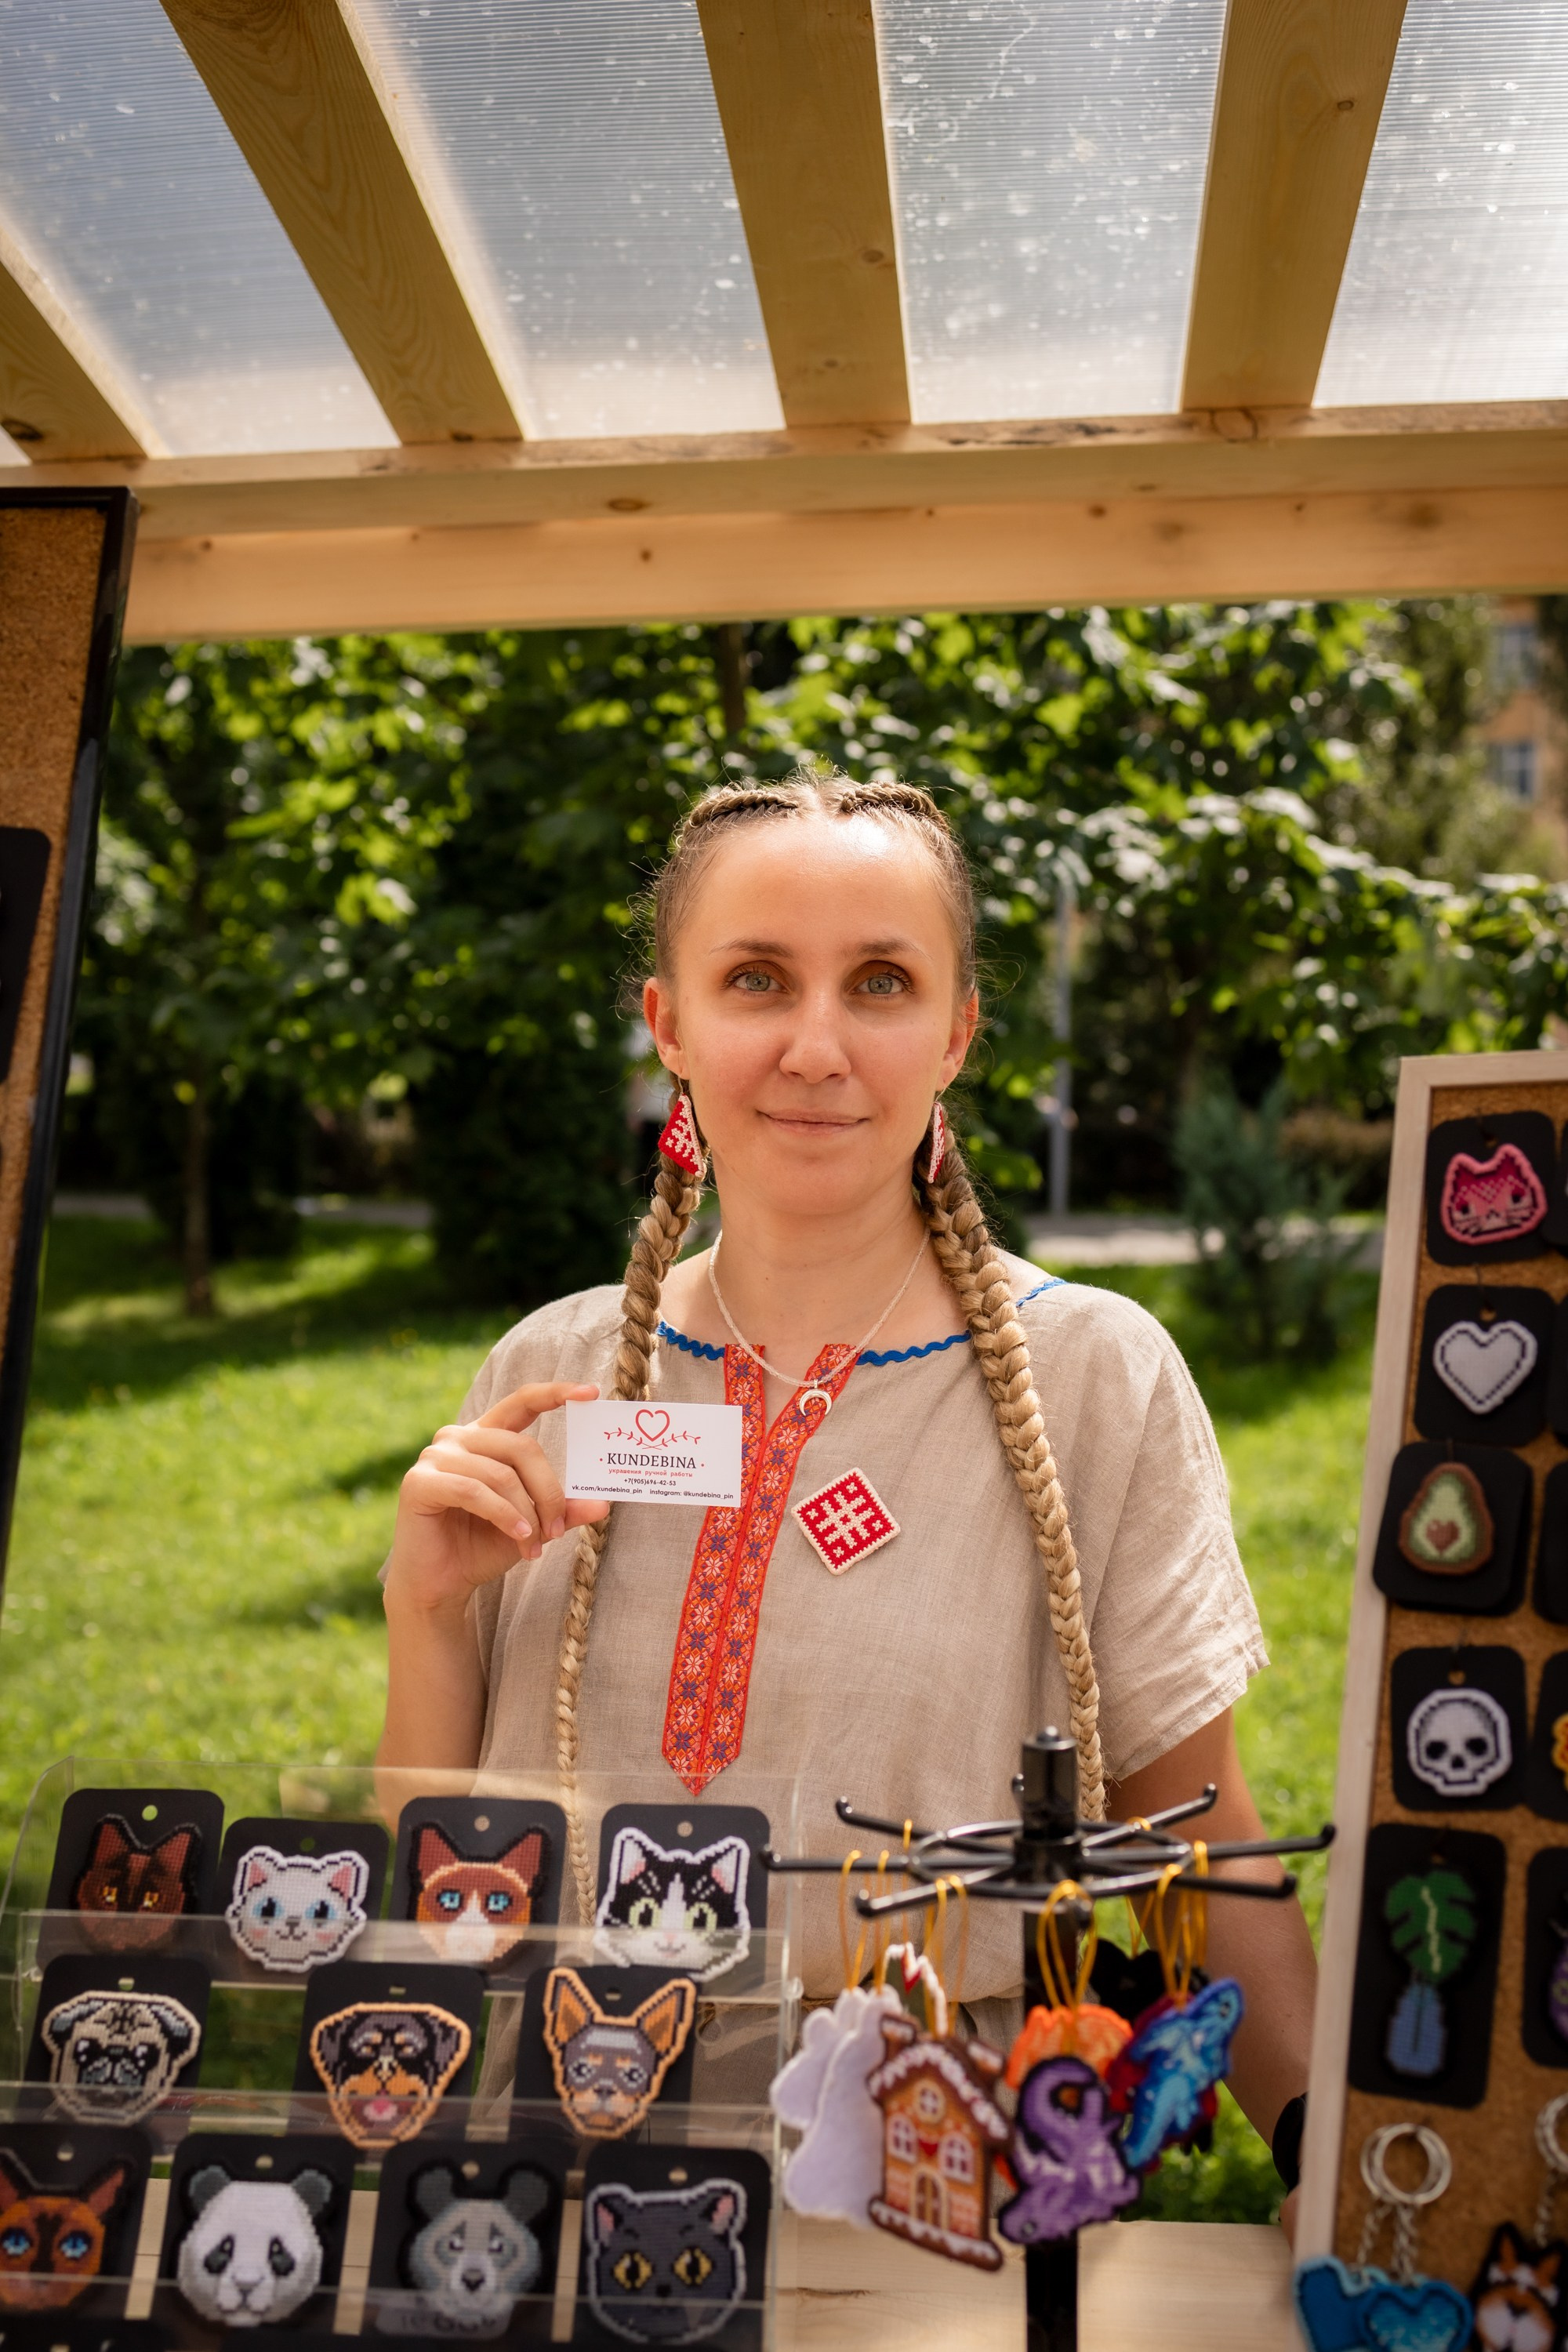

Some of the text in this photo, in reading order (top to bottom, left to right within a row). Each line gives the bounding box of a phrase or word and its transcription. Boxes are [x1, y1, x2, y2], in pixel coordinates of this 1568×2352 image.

[607, 1453, 697, 1469] KUNDEBINA
[644, 1468, 667, 1477] ручной
[623, 1478, 677, 1486] +7(905)696-42-53
[572, 1485, 643, 1494] vk.com/kundebina_pin
[683, 1490, 734, 1499] @kundebina_pin
